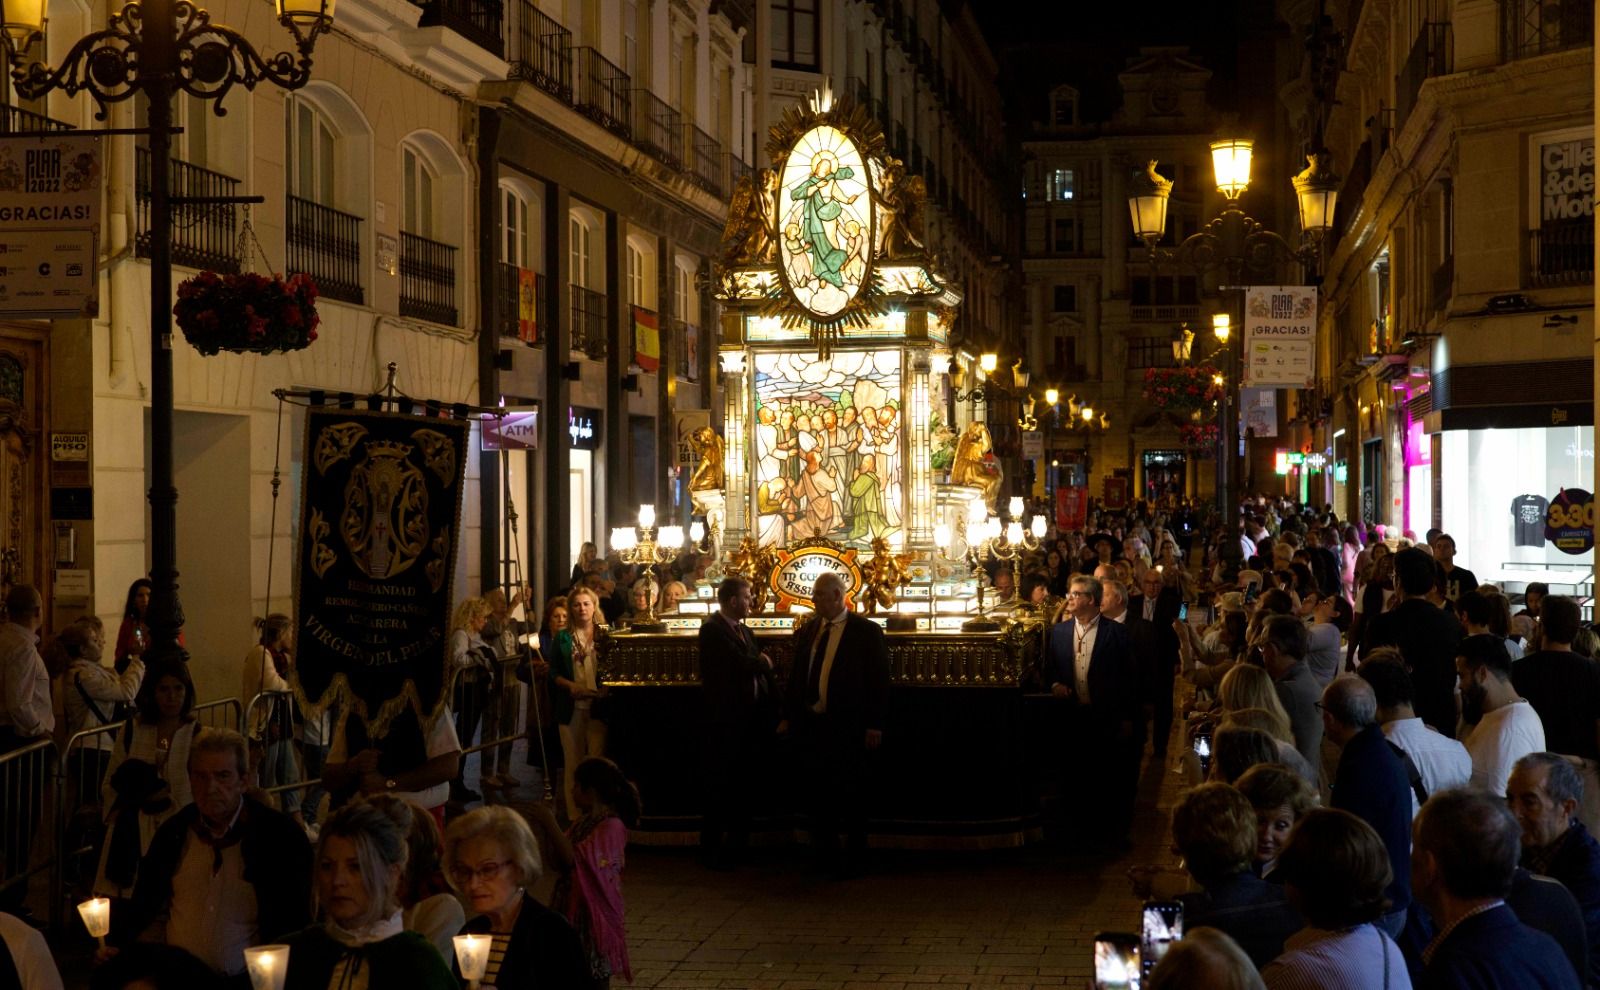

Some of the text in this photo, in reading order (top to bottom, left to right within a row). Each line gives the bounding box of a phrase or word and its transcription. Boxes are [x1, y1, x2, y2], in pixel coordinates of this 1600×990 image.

[26, 149, 61, 192] PILAR
[31, 179, 60, 192] 2022
[0, 205, 90, 221] GRACIAS!
[1272, 294, 1293, 319] PILAR
[1274, 311, 1292, 319] 2022
[1252, 326, 1310, 336] ¡GRACIAS!
[505, 425, 534, 436] ATM
[53, 435, 86, 443] ALQUILO
[680, 453, 701, 463] BEL
[786, 581, 814, 595] ASSU
